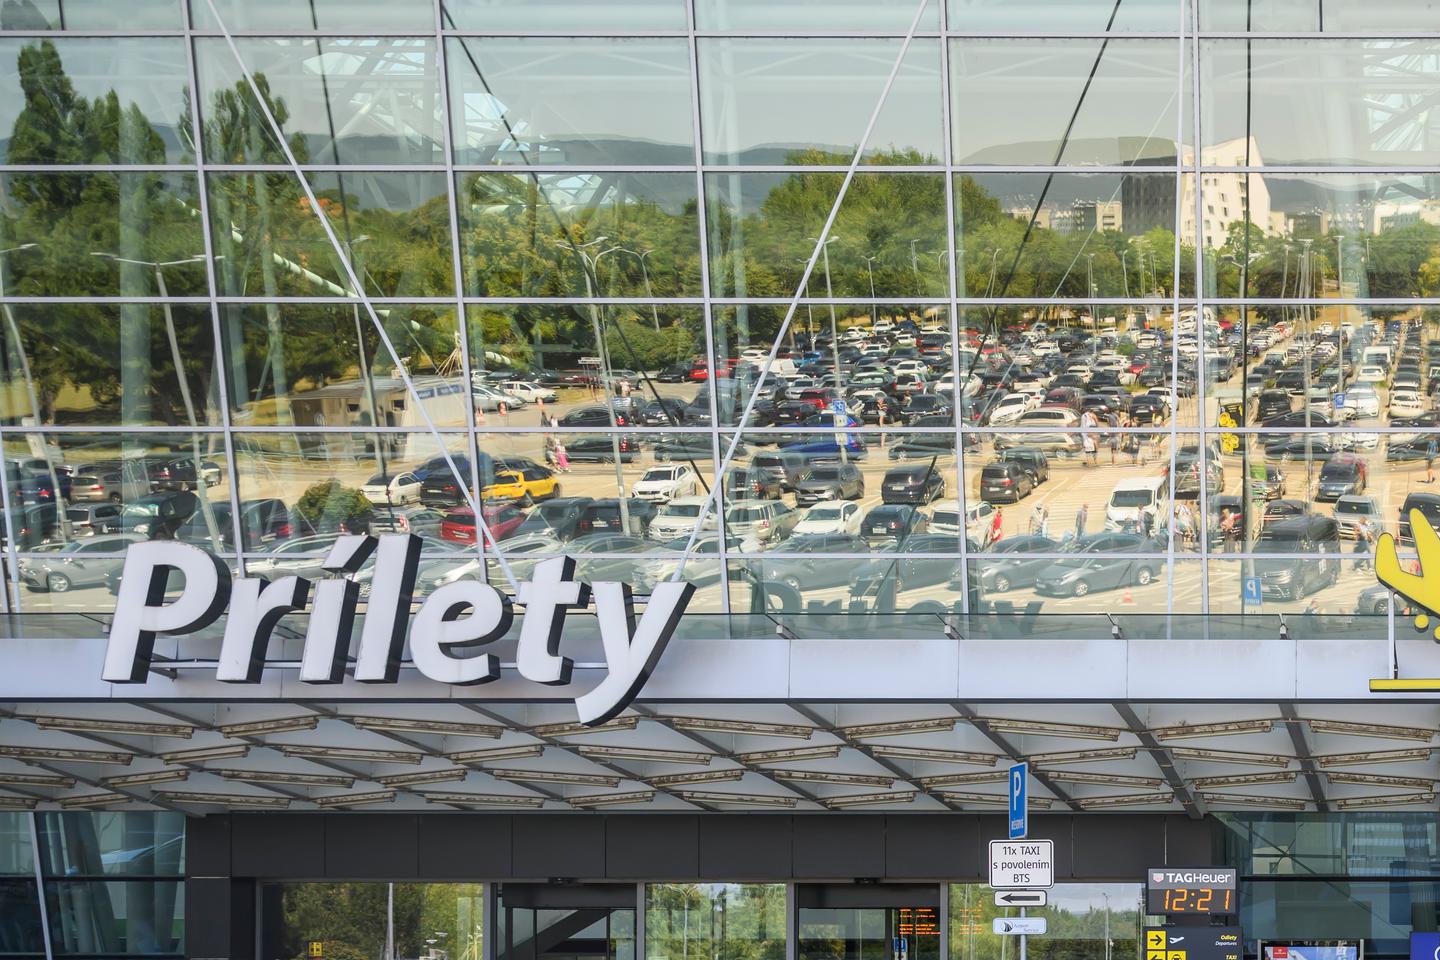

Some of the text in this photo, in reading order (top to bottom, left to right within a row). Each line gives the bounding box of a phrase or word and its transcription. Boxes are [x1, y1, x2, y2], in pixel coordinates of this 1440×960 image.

[102, 534, 697, 726] Prílety
[1013, 771, 1022, 811] P
[1002, 846, 1040, 856] 11x TAXI
[993, 862, 998, 870] s
[1013, 874, 1030, 883] BTS
[1164, 889, 1230, 911] 12:21
